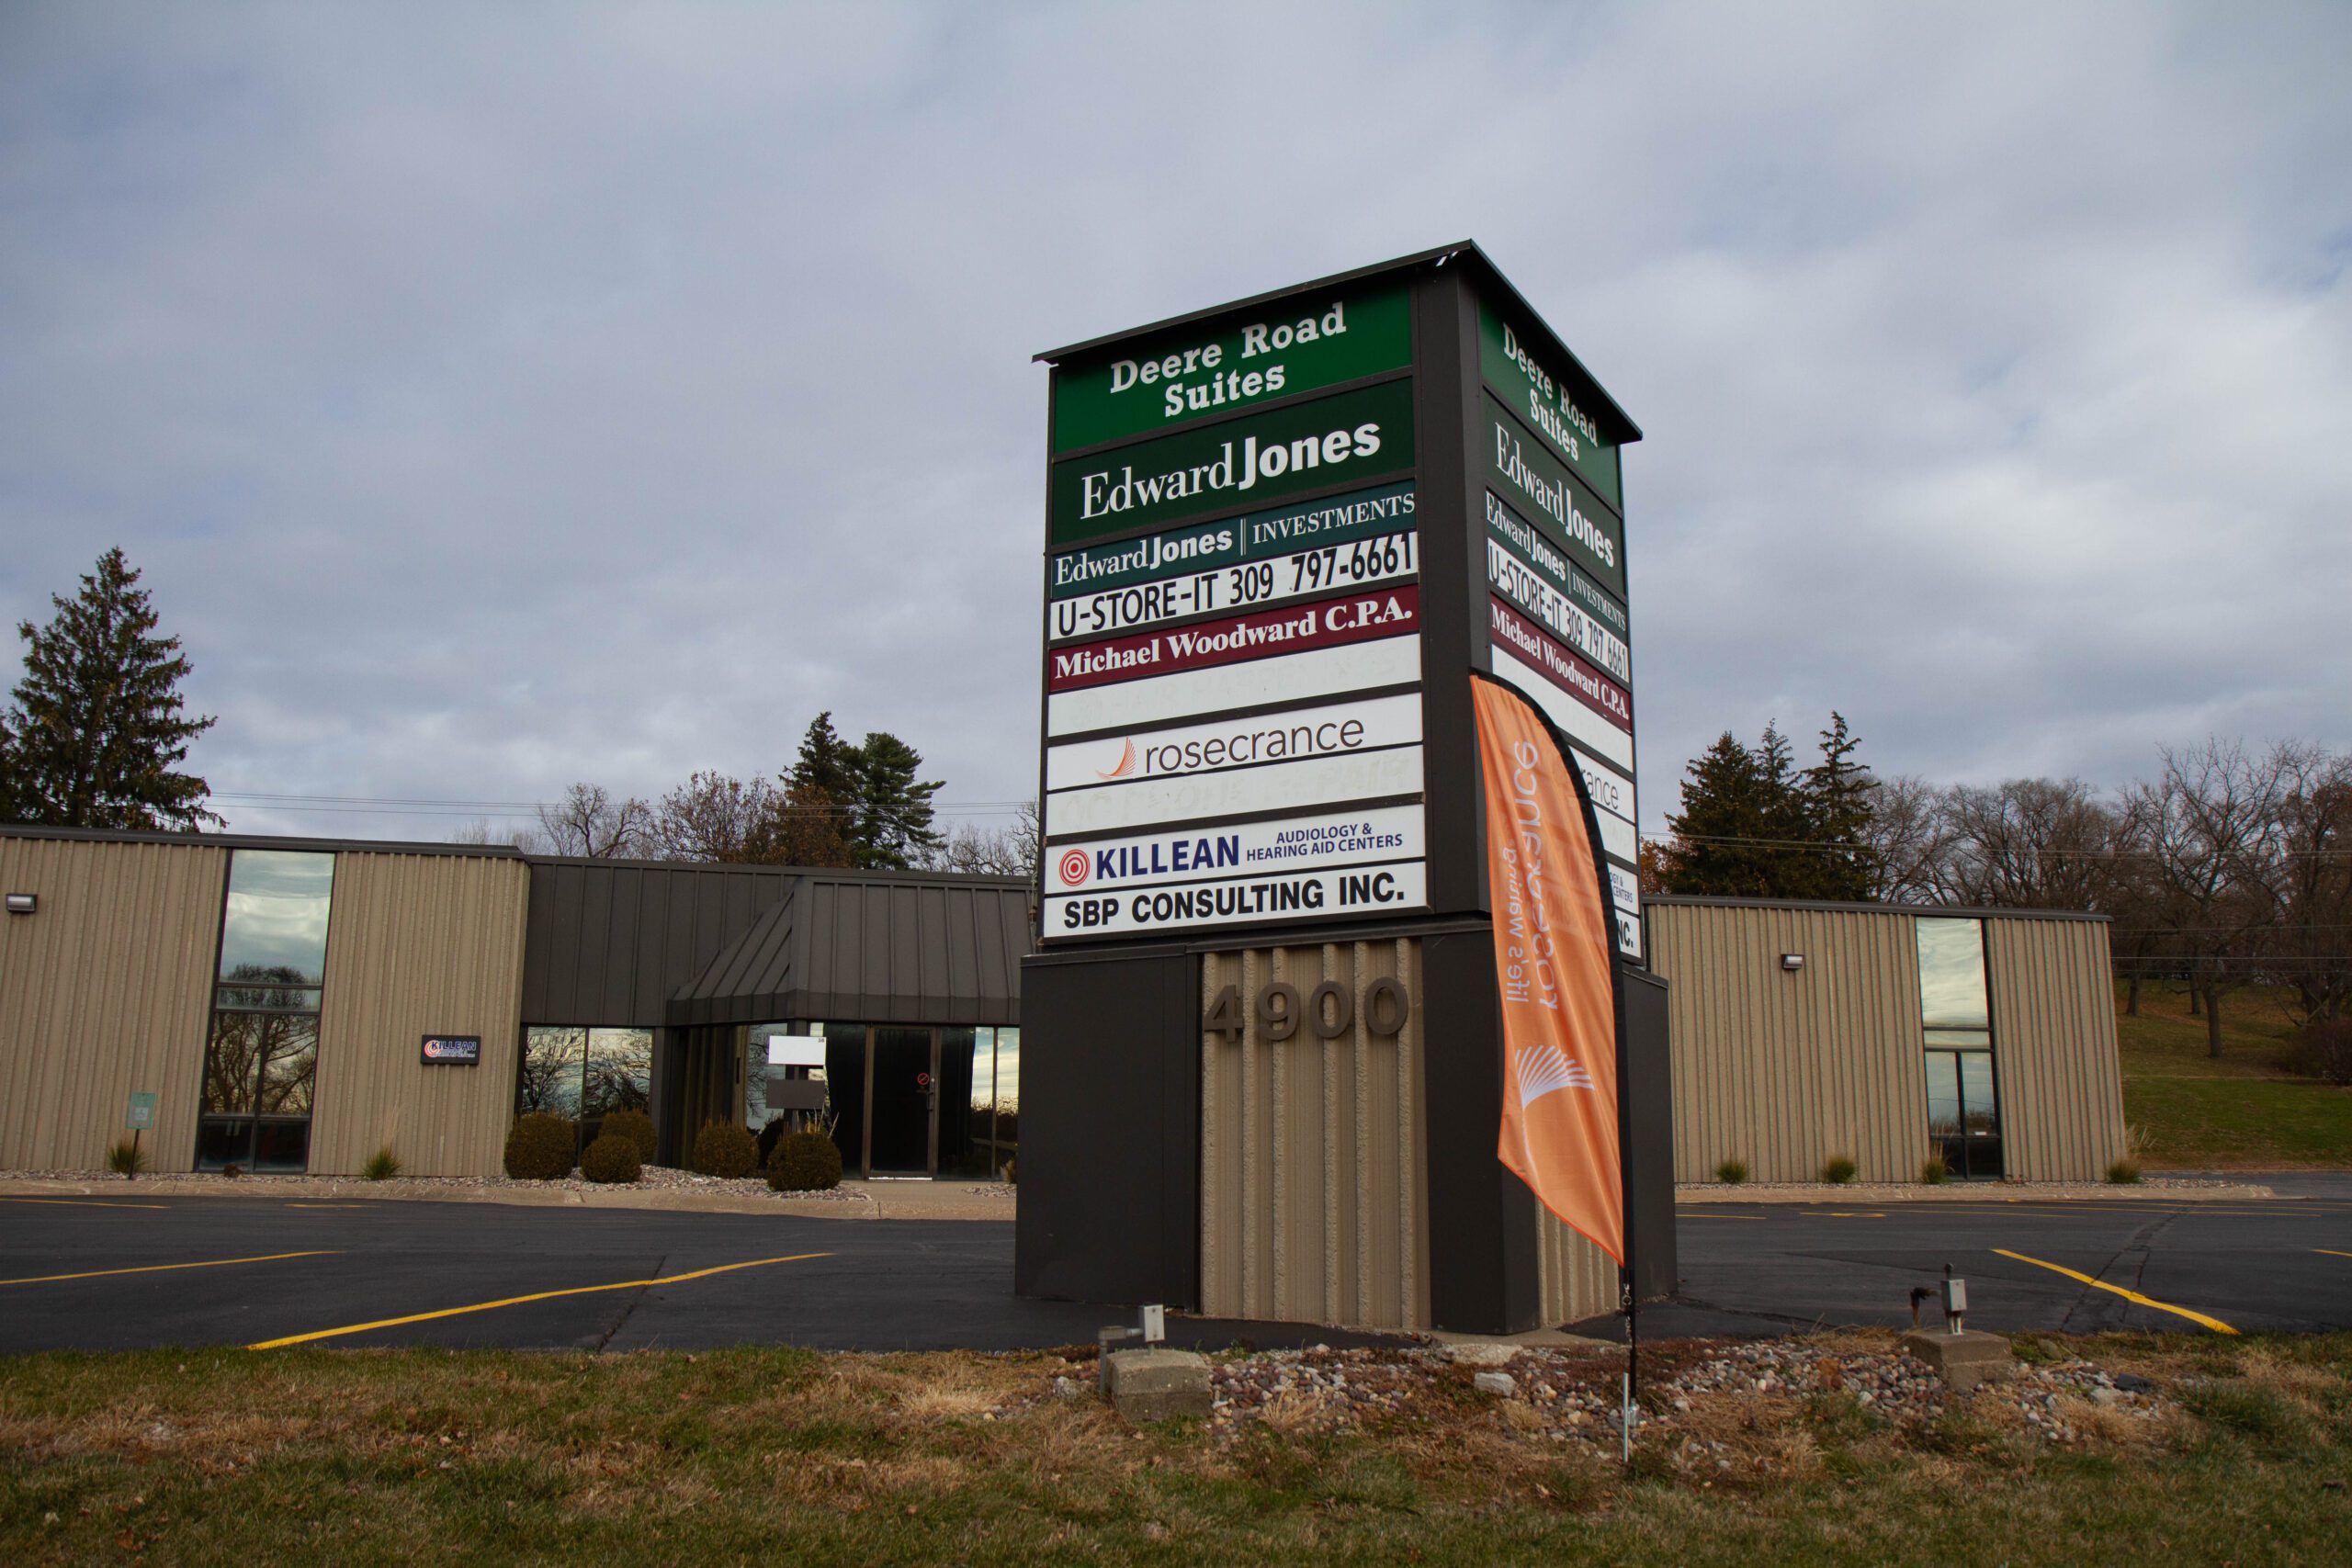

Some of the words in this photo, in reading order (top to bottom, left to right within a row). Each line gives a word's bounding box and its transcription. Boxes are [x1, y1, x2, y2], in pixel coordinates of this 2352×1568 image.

[1110, 344, 1223, 393] Deere
[1241, 301, 1347, 359] Road
[1165, 364, 1285, 417] Suites
[1503, 322, 1554, 400] Deere
[1559, 382, 1599, 447] Road
[1530, 389, 1578, 461] Suites
[1252, 492, 1416, 544] INVESTMENTS
[1058, 573, 1219, 637] U-STORE-IT
[1229, 562, 1274, 603] 309
[1291, 532, 1414, 592] 797-6661
[1489, 545, 1562, 633] U-STORE-IT
[1566, 605, 1582, 649] 309
[1572, 572, 1626, 631] INVESTMENTS
[1055, 640, 1160, 680] Michael
[1167, 610, 1317, 656] Woodward
[1325, 596, 1413, 632] C.P.A.
[1491, 604, 1542, 660] Michael
[1543, 640, 1600, 700] Woodward
[1601, 683, 1629, 720] C.P.A.
[1145, 719, 1364, 773] rosecrance
[1096, 835, 1239, 880] KILLEAN
[1247, 843, 1308, 862] HEARING
[1310, 840, 1335, 855] AID
[1338, 833, 1403, 852] CENTERS
[1276, 824, 1359, 844] AUDIOLOGY
[1362, 822, 1373, 835] &
[1064, 897, 1119, 929] SBP
[1132, 879, 1324, 924] CONSULTING
[1339, 872, 1405, 906] INC.
[1613, 886, 1633, 903] CENTERS
[1618, 919, 1634, 948] NC.
[1204, 976, 1408, 1043] 4900
[432, 1041, 476, 1051] KILLEAN
